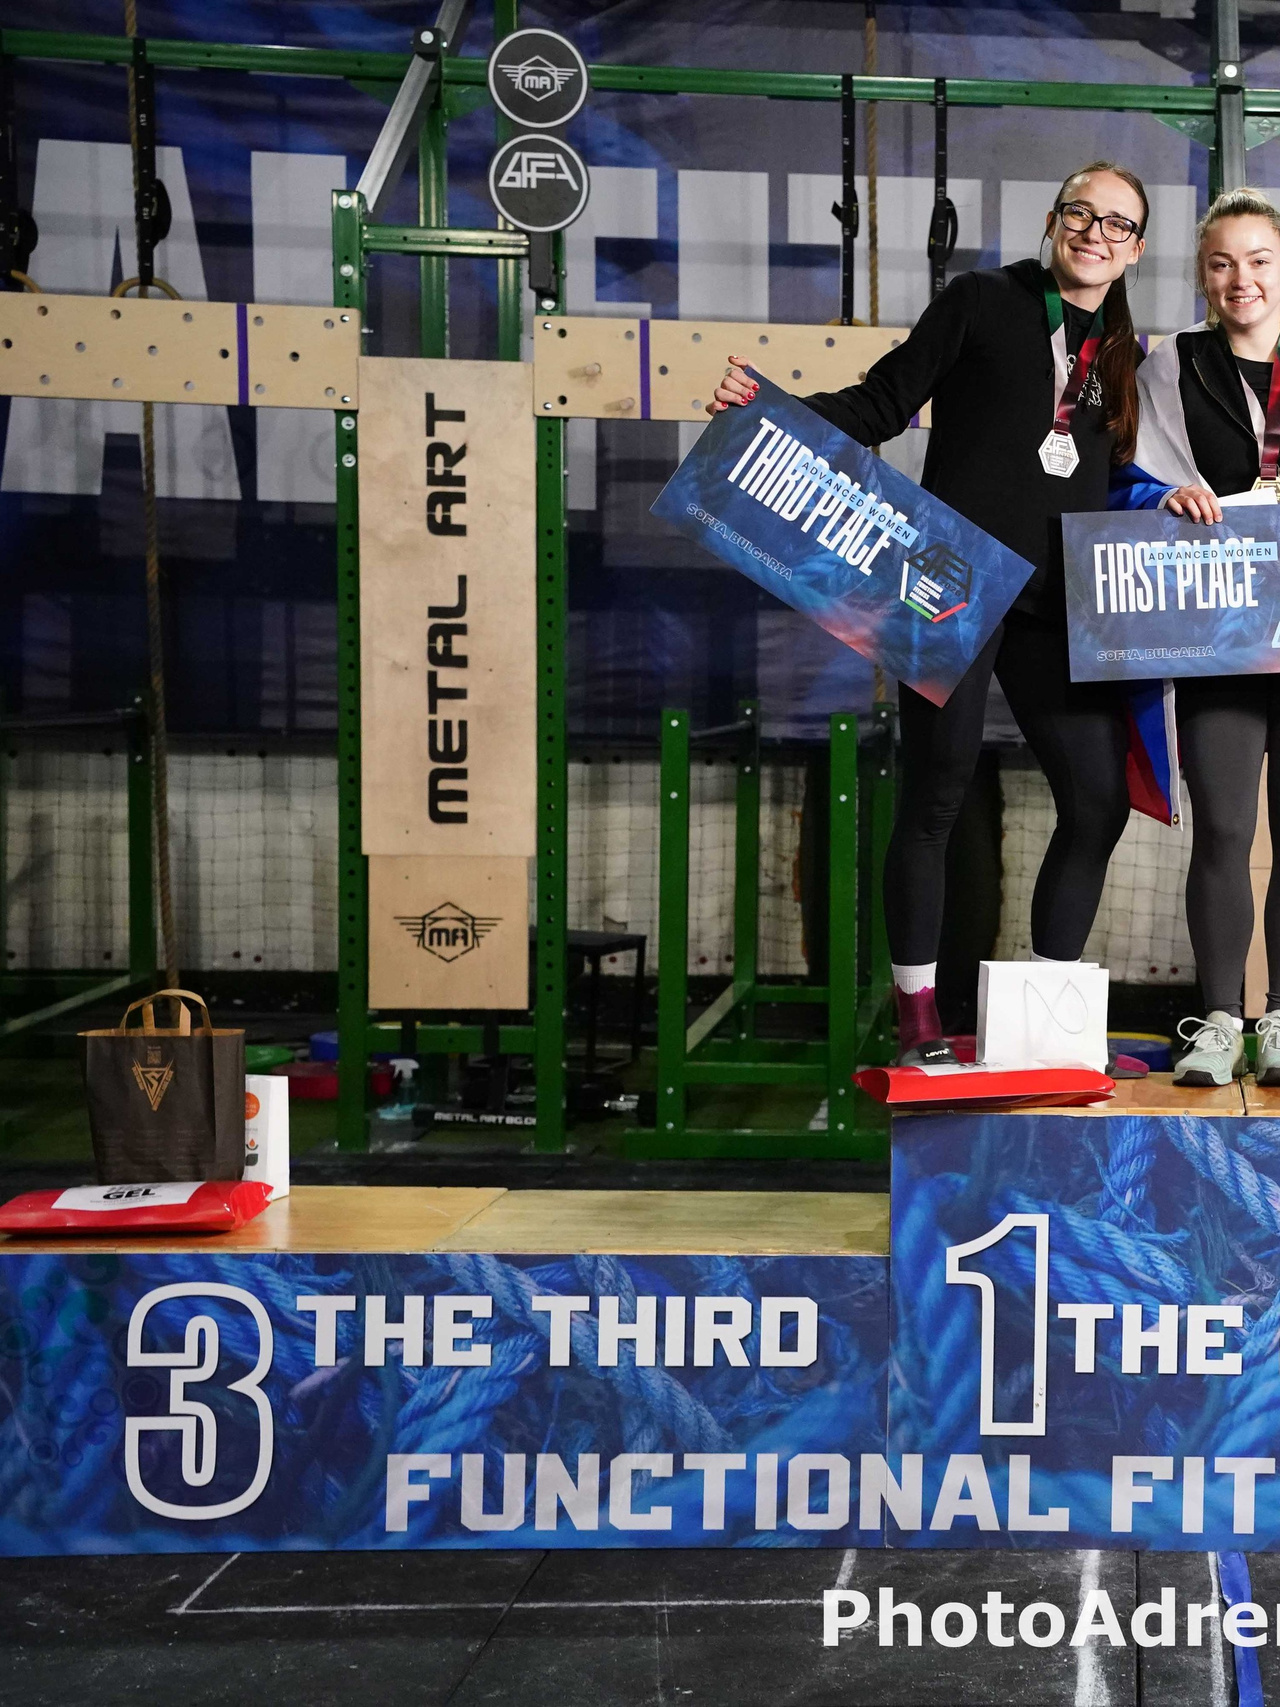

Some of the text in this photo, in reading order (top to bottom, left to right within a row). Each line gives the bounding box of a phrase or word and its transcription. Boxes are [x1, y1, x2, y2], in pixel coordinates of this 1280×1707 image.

[727, 416, 909, 577] THIRD PLACE
[801, 461, 911, 540] ADVANCED WOMEN
[686, 502, 793, 582] SOFIA, BULGARIA
[1094, 537, 1259, 614] FIRST PLACE
[1148, 547, 1272, 562] ADVANCED WOMEN
[426, 391, 469, 825] METAL ART
[1096, 645, 1216, 662] SOFIA, BULGARIA
[428, 926, 470, 949] MA
[434, 1111, 478, 1122] METAL
[102, 1188, 156, 1200] GEL
[296, 1294, 819, 1368] THE THIRD
[945, 1213, 1050, 1437] 1
[1057, 1302, 1245, 1376] THE
[124, 1280, 274, 1521] 3
[385, 1451, 1071, 1534] FUNCTIONAL
